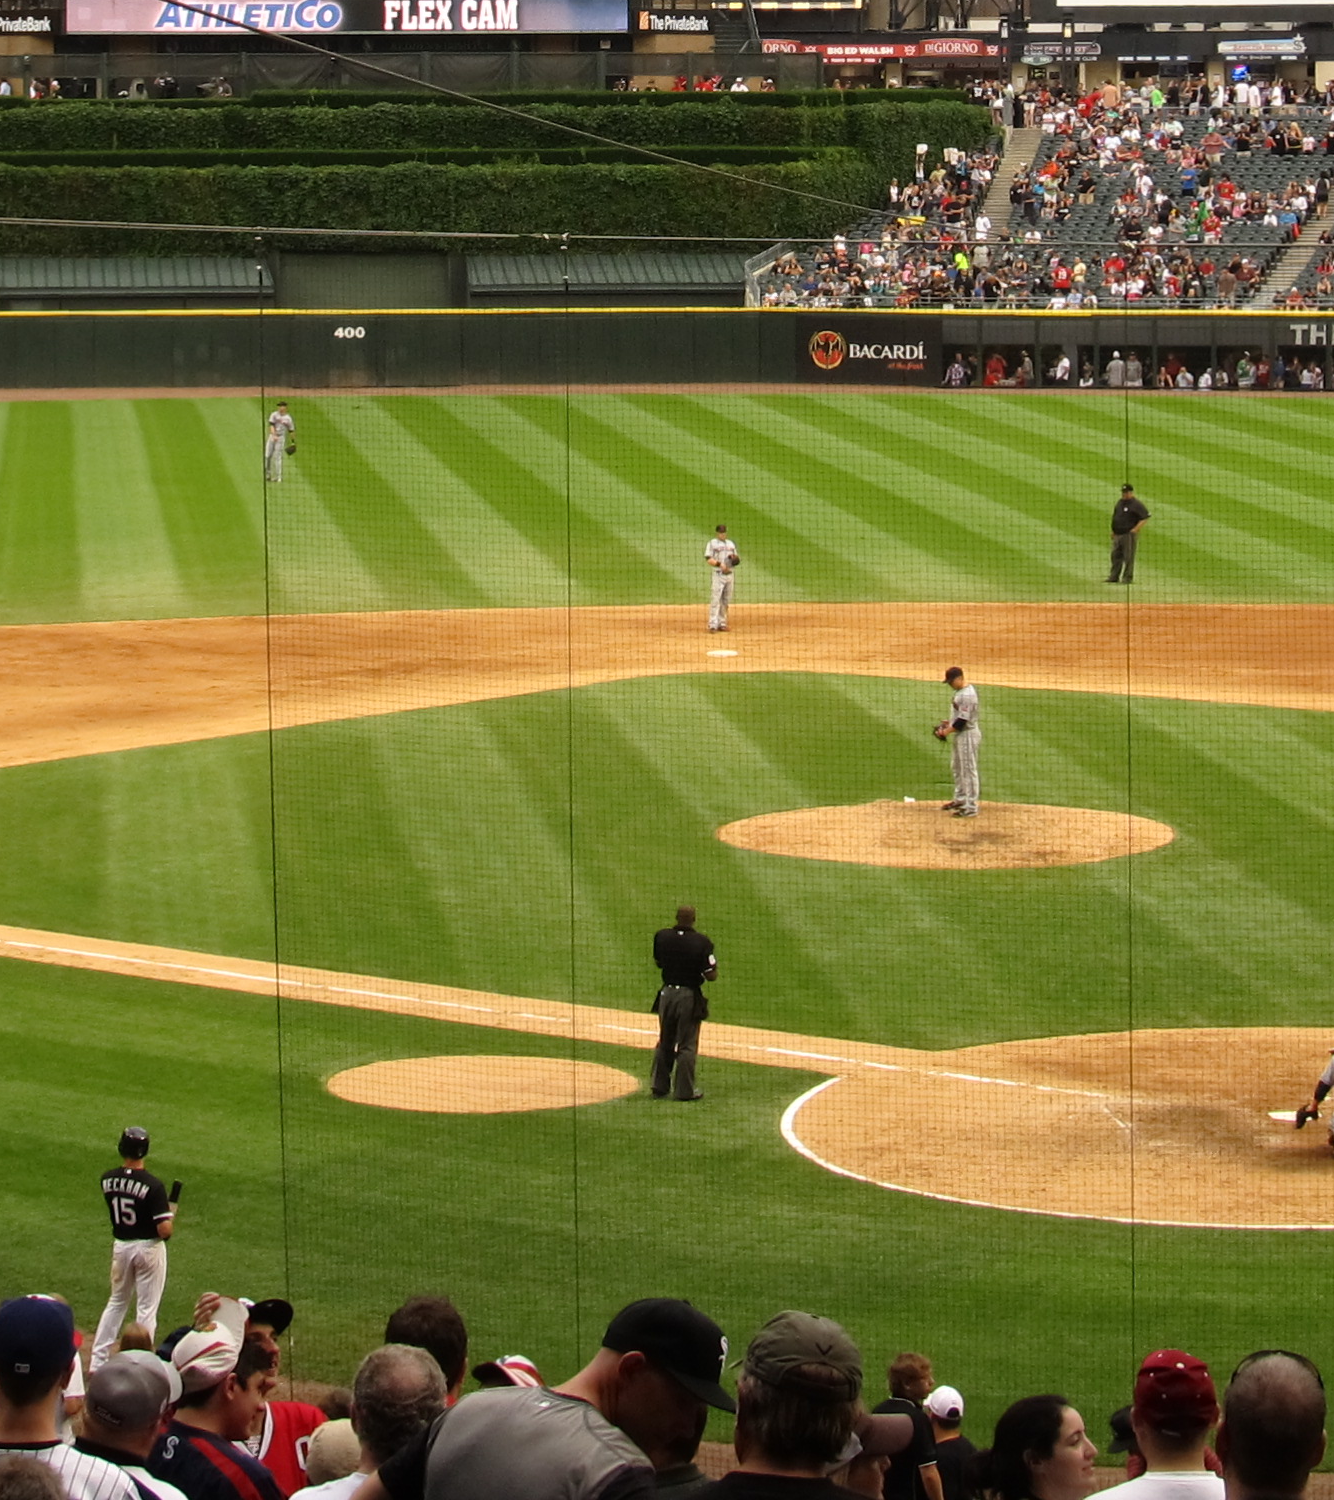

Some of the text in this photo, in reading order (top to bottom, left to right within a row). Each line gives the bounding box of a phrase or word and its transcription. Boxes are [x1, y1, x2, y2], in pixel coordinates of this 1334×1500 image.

[384, 0, 518, 30] FLEX CAM
[859, 46, 894, 55] WALSH
[333, 327, 366, 340] 400
[1290, 324, 1333, 347] THE
[112, 1197, 137, 1226] 15
